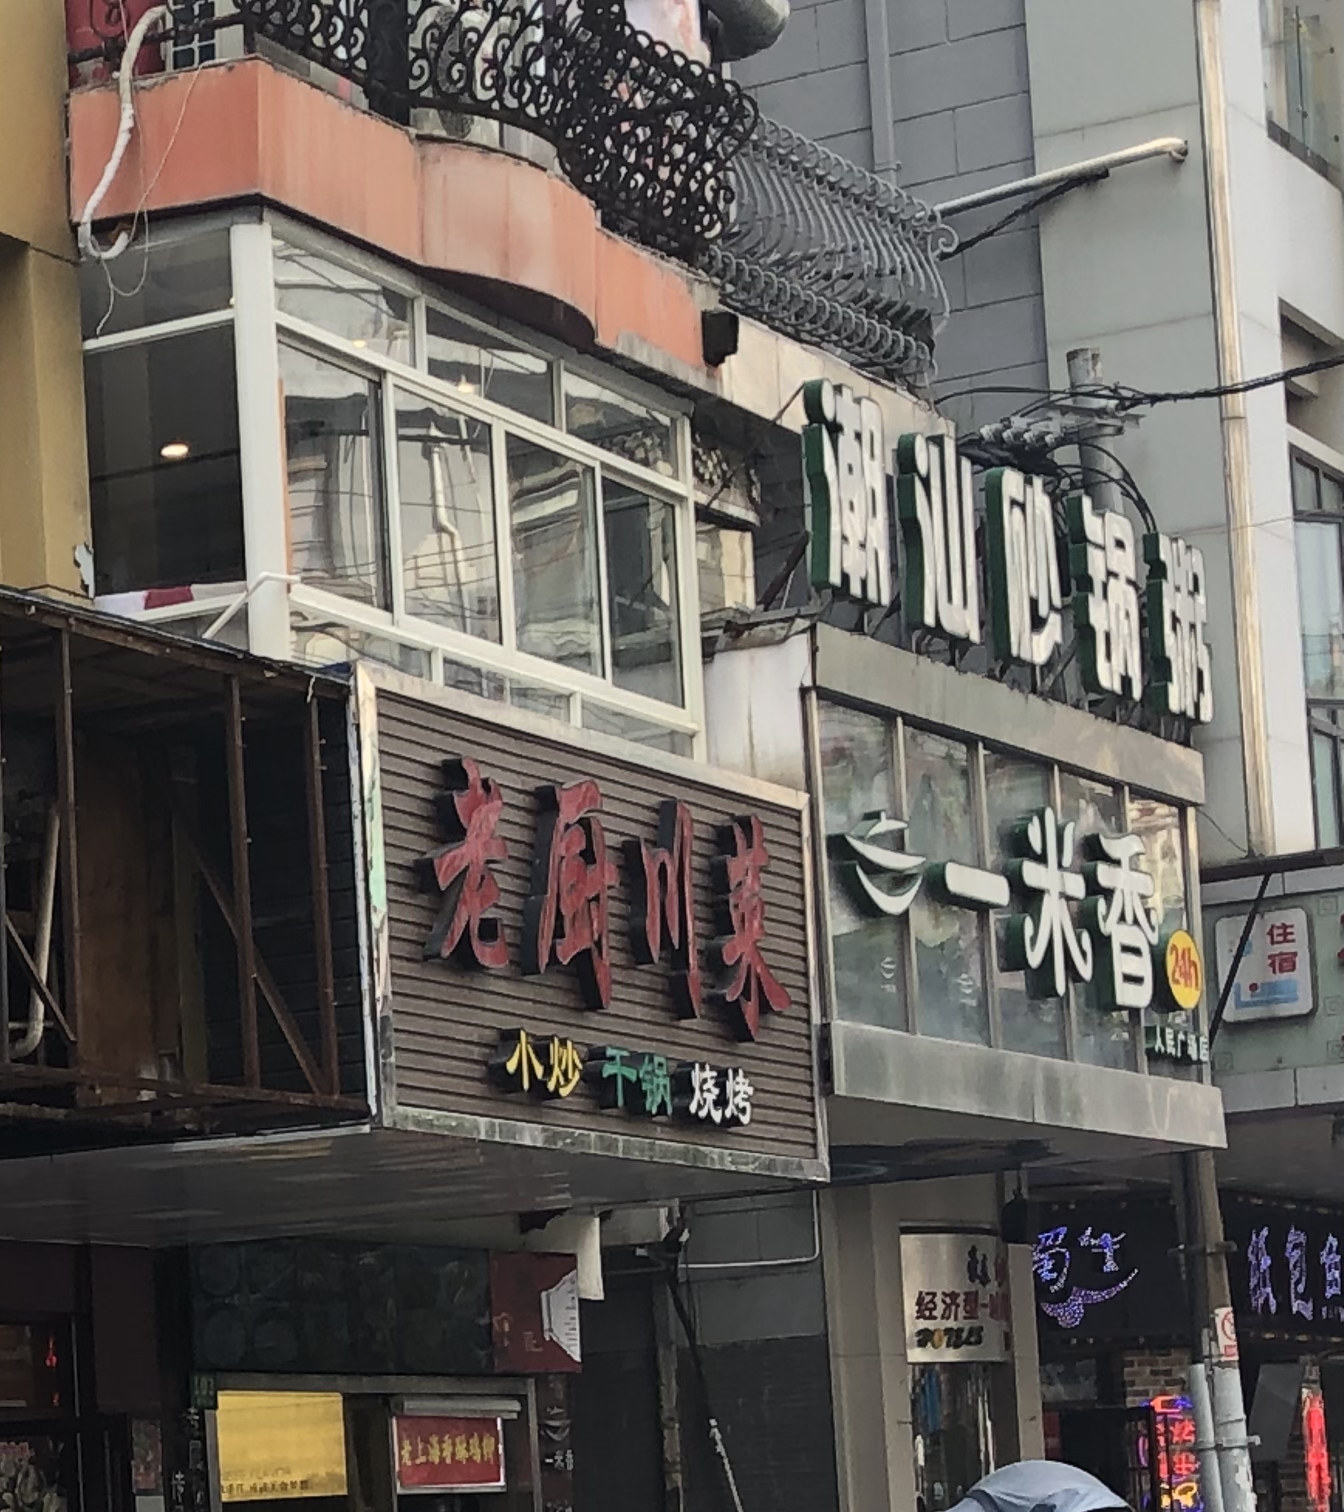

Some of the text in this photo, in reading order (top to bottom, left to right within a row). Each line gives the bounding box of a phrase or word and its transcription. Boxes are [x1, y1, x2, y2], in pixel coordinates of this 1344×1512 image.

[1169, 943, 1200, 992] 24h
[1266, 922, 1299, 975] 住宿
[506, 1029, 583, 1098] 小炒
[688, 1062, 754, 1126] 烧烤
